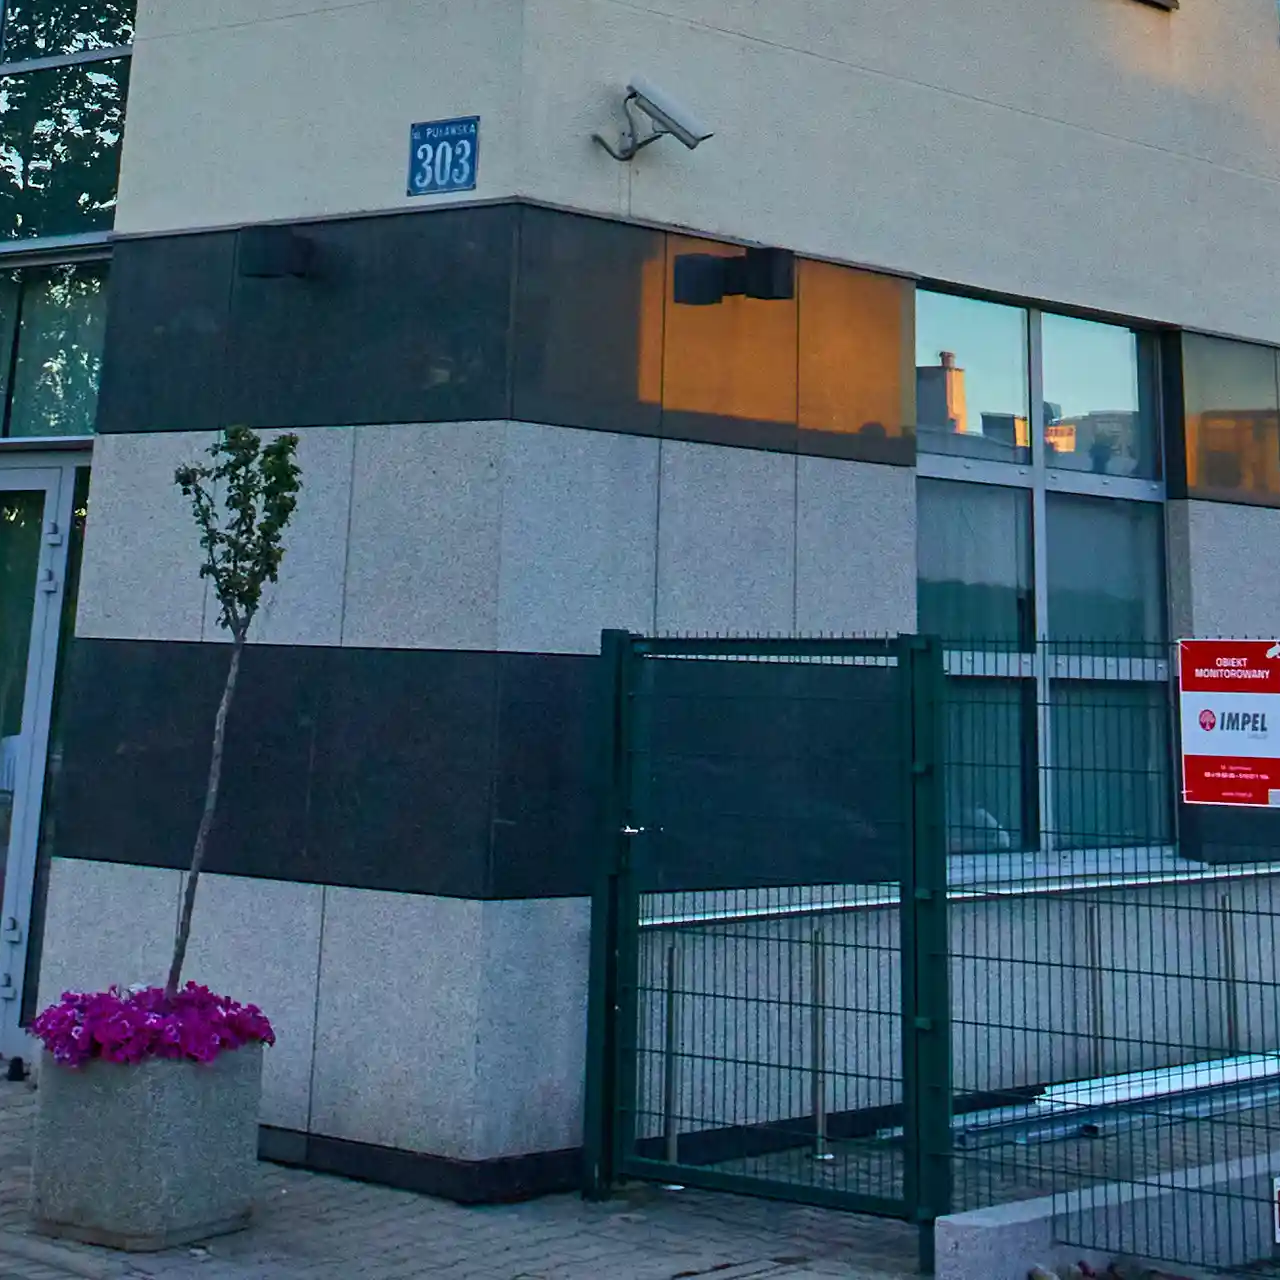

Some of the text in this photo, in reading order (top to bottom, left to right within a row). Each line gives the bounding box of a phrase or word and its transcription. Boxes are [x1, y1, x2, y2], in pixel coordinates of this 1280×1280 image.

[415, 139, 471, 187] 303
[1215, 657, 1248, 668] OBIEKT
[1194, 667, 1270, 679] MONITOROWANY
[1220, 711, 1268, 732] IMPEL
